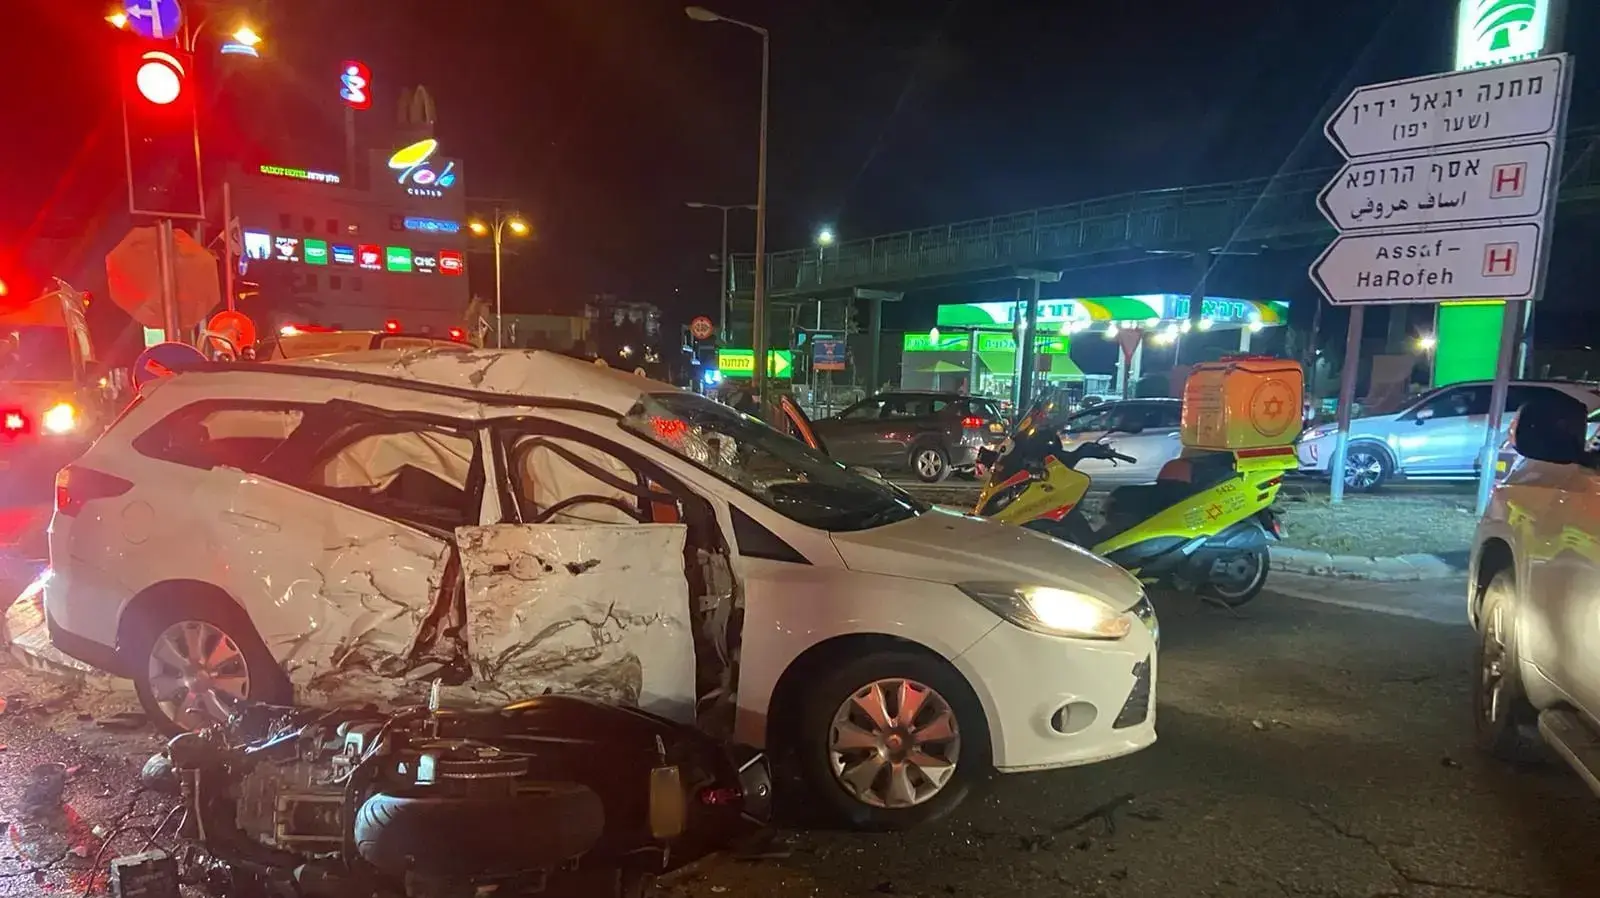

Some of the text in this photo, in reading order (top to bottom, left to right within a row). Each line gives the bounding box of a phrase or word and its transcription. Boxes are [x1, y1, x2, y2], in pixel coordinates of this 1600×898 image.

[1353, 75, 1543, 125] מחנה יגאל ידין
[285, 168, 308, 179] HOTEL
[1346, 157, 1481, 189] אסף הרופא
[1496, 167, 1520, 192] H
[1350, 191, 1467, 222] اساف هروفي
[1488, 248, 1512, 273] H
[1357, 268, 1454, 288] HaRofeh
[1048, 303, 1073, 317] דור
[1220, 301, 1245, 317] דור
[721, 357, 750, 368] לתחנה
